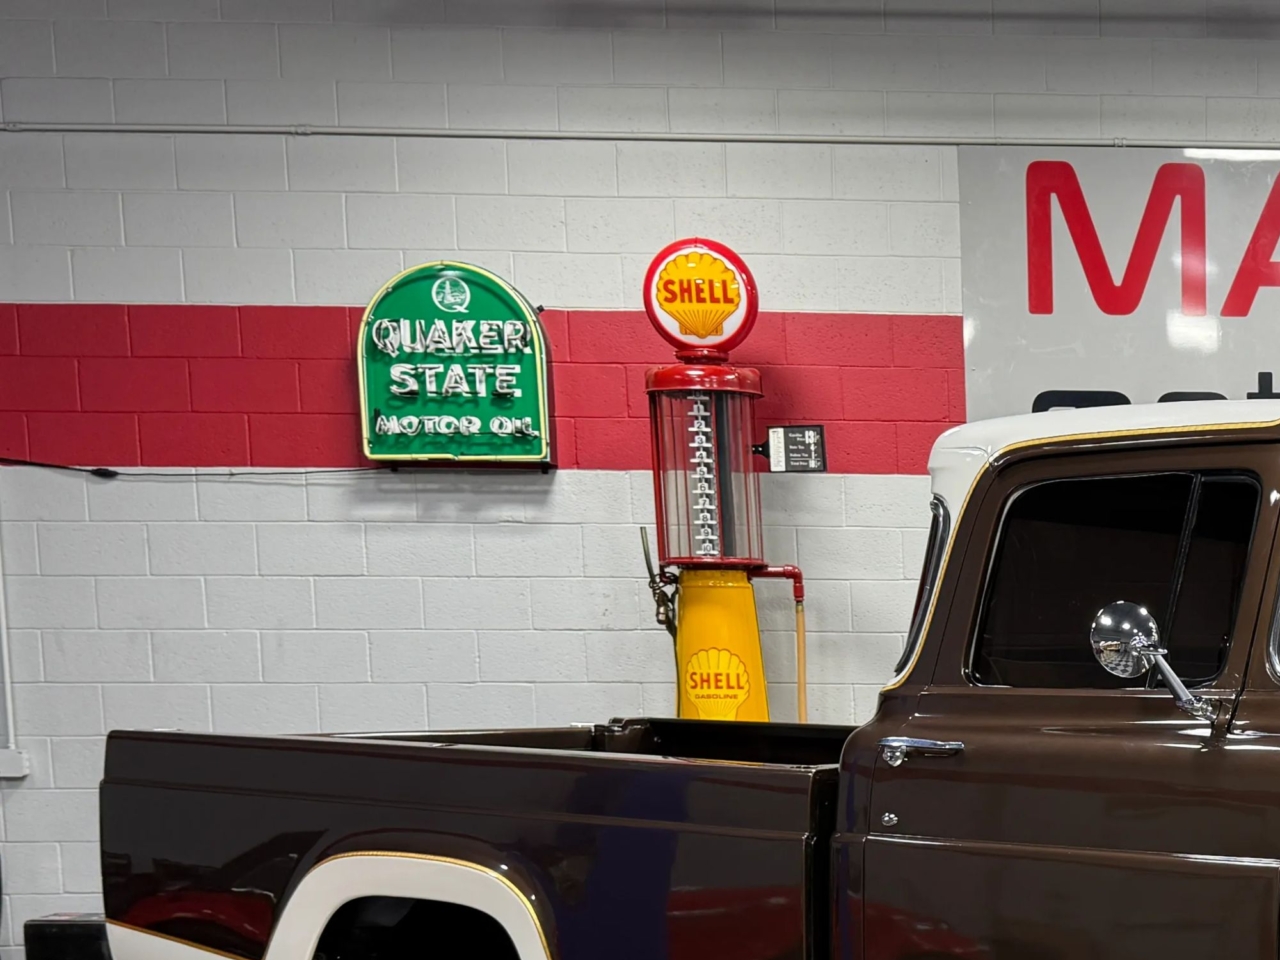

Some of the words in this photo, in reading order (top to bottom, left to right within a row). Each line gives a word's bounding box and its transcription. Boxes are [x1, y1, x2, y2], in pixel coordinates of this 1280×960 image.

[662, 279, 735, 304] SHELL
[372, 318, 533, 358] QUAKER
[390, 363, 523, 397] STATE
[375, 415, 482, 436] MOTOR
[490, 415, 541, 437] OIL
[689, 671, 745, 690] SHELL
